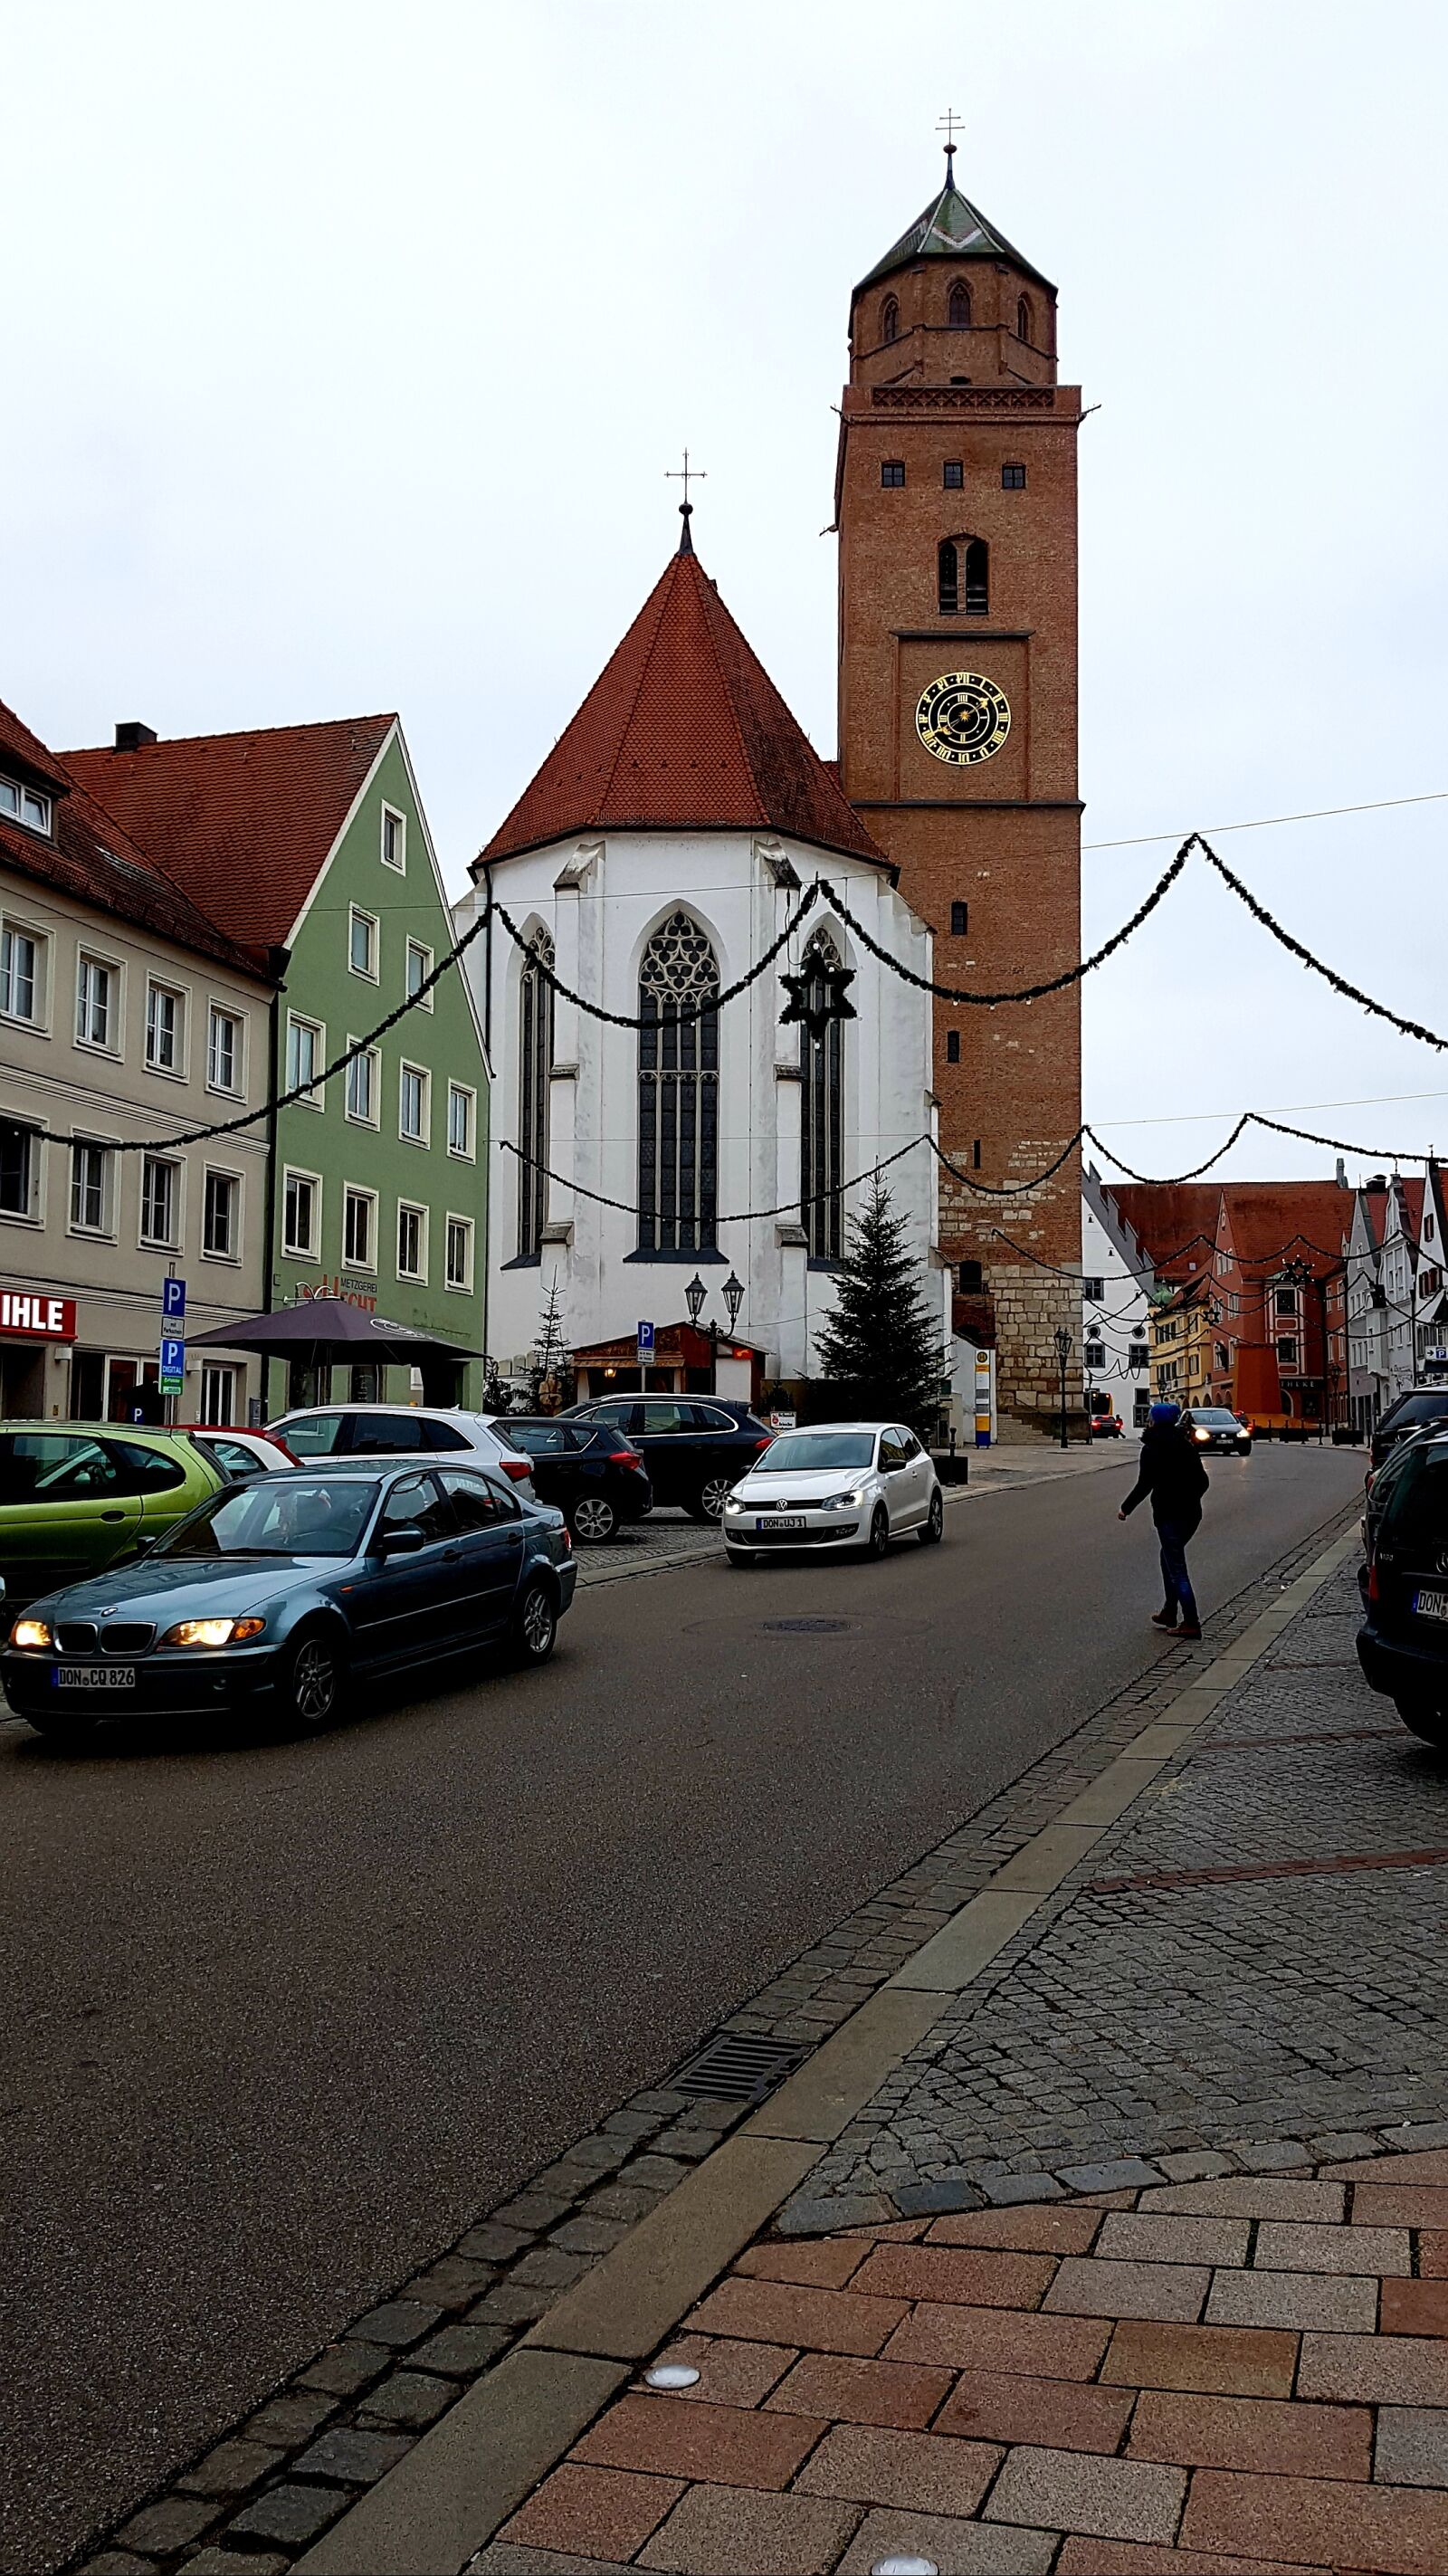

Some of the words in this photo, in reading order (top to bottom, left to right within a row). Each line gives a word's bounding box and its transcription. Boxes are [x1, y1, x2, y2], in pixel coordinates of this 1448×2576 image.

[340, 1277, 376, 1293] METZGEREI
[168, 1283, 180, 1312] P
[2, 1294, 63, 1331] IHLE
[642, 1325, 651, 1344] P
[168, 1343, 178, 1365] P
[1439, 1350, 1444, 1359] P
[162, 1366, 183, 1375] DIGITAL
[135, 1408, 143, 1422] P
[763, 1520, 779, 1528] DON
[1418, 1593, 1443, 1614] DON
[59, 1669, 81, 1685] DON
[90, 1670, 107, 1685] CQ
[110, 1670, 134, 1686] 826
